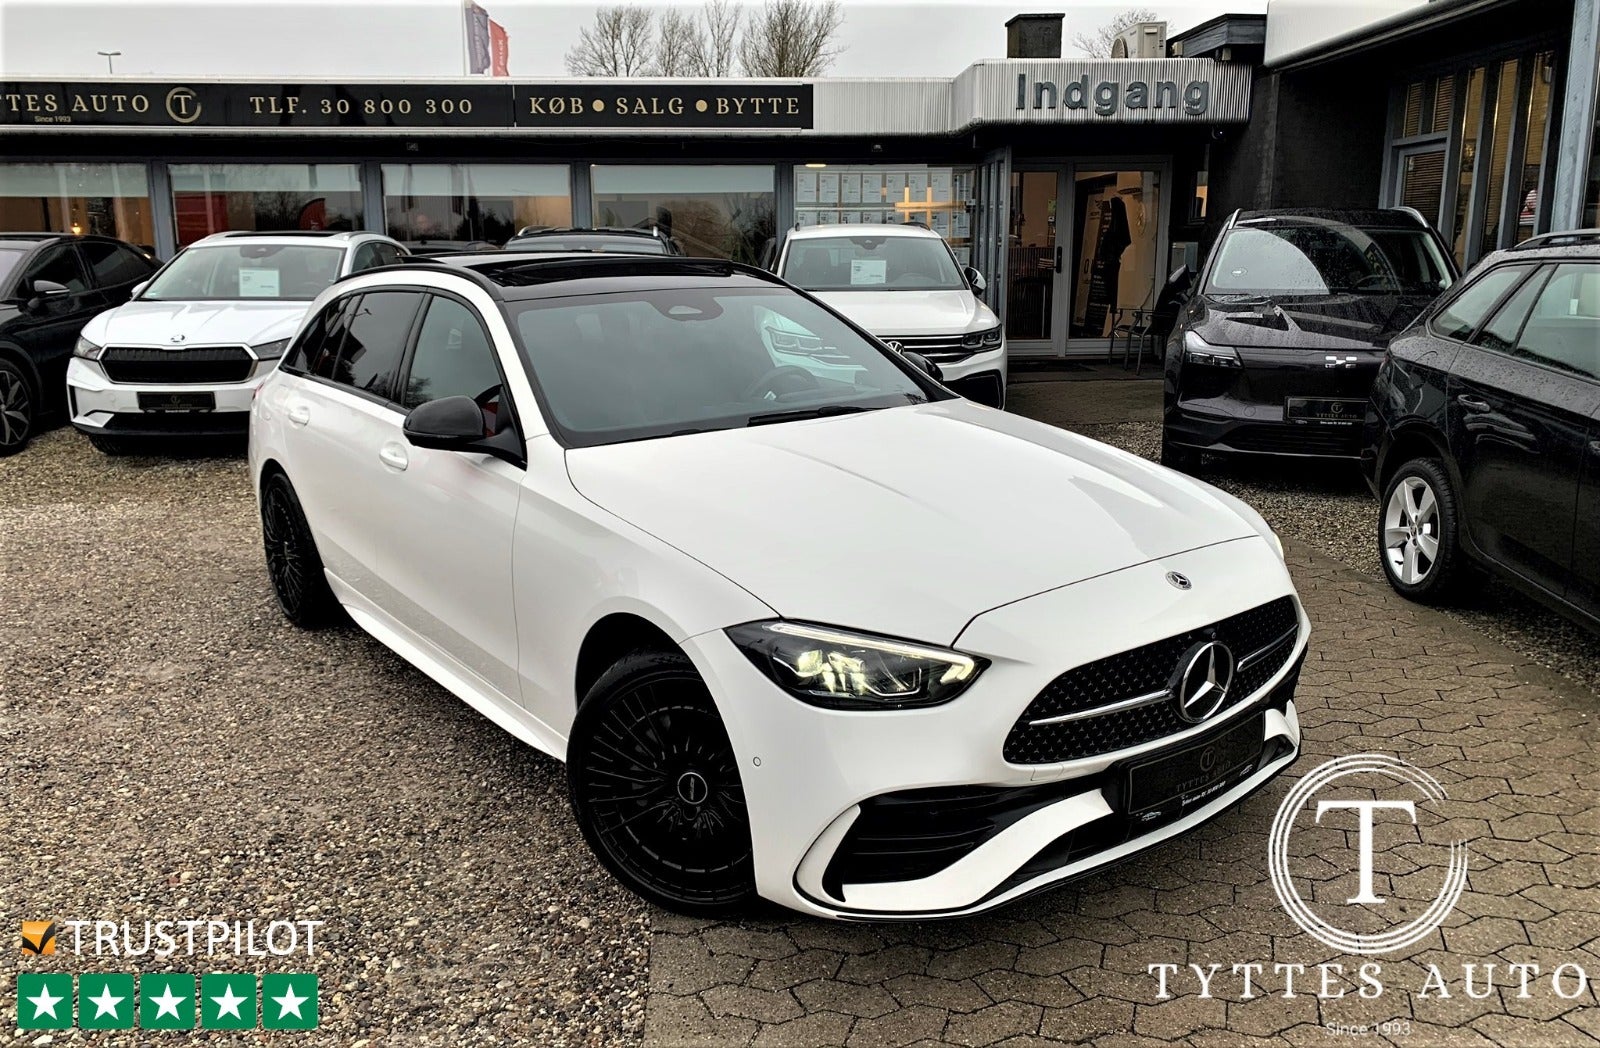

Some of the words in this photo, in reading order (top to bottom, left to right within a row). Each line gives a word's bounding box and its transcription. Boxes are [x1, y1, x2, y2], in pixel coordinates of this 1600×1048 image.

[0, 94, 58, 112] TES
[72, 94, 149, 113] AUTO
[1016, 73, 1209, 116] Indgang
[250, 96, 307, 114] TLF.
[321, 99, 350, 115] 30
[365, 99, 411, 115] 800
[426, 99, 473, 115] 300
[529, 97, 584, 115] KØB
[616, 97, 685, 115] SALG
[716, 97, 800, 115] BYTTE
[34, 115, 54, 123] Since
